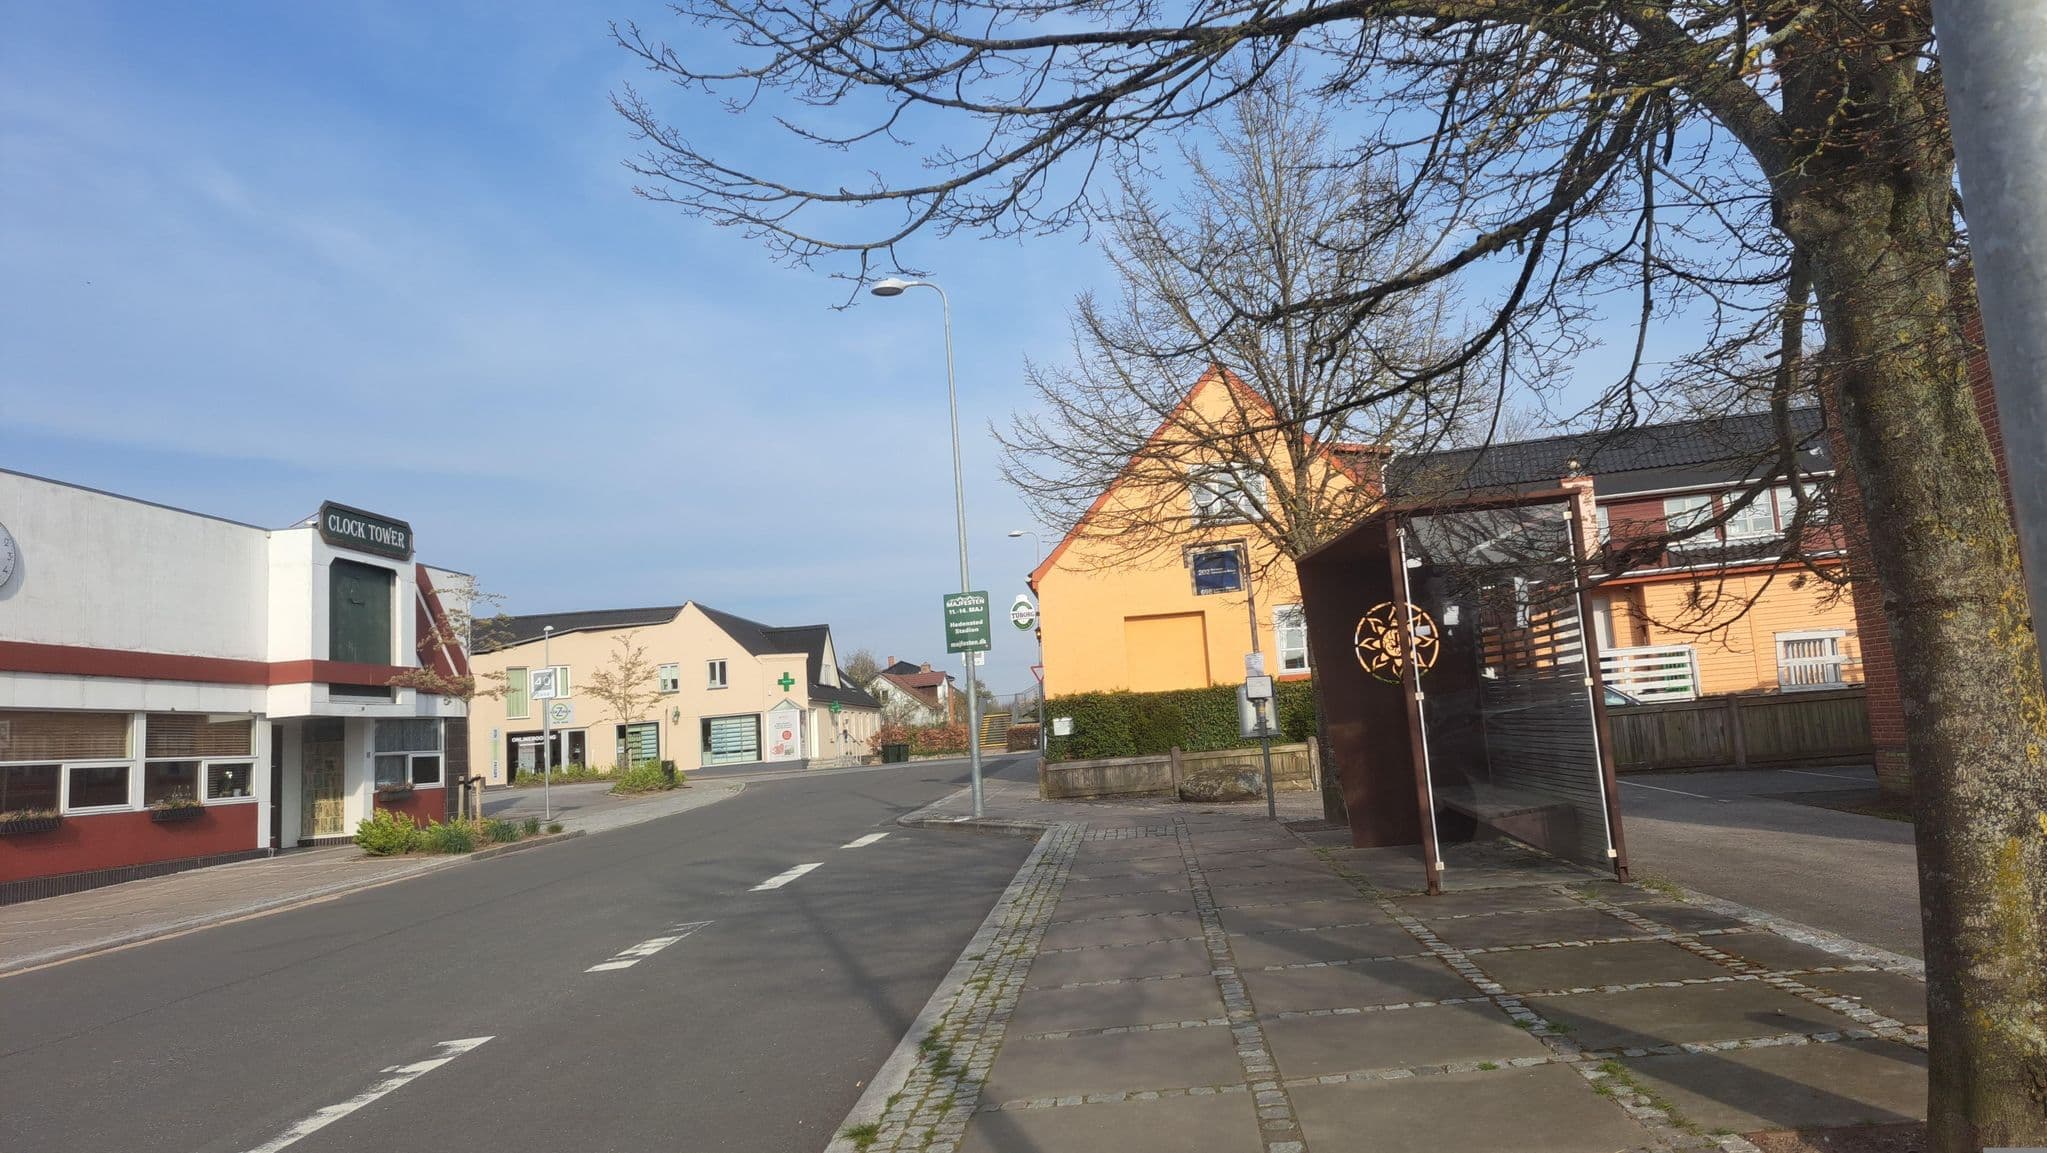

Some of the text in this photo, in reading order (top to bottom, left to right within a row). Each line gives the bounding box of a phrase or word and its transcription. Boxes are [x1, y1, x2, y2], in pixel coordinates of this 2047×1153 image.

[328, 514, 405, 548] CLOCK TOWER
[535, 676, 551, 686] 40
